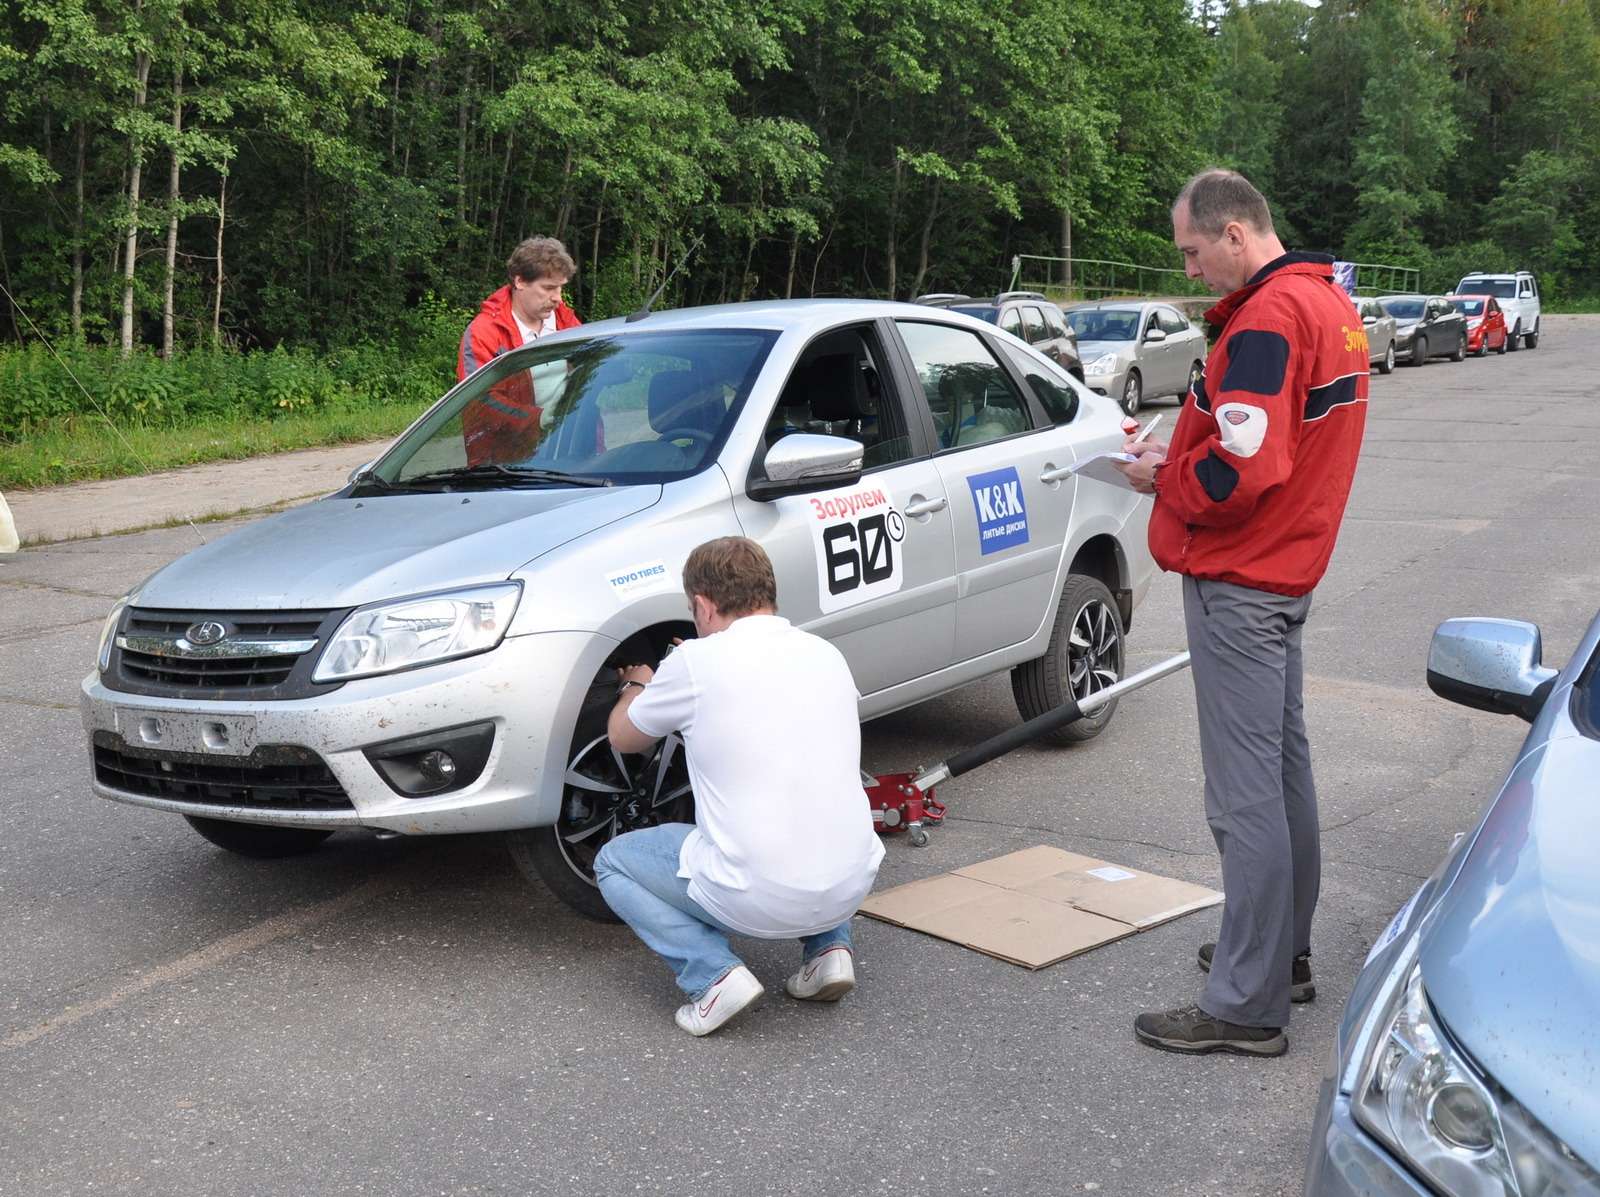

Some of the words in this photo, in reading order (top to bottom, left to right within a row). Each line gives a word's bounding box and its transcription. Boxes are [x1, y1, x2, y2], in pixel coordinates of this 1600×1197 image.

[810, 488, 887, 519] Зарулем
[975, 481, 1024, 523] K&K
[983, 526, 1005, 540] литые
[1006, 520, 1026, 534] диски
[823, 513, 893, 595] 60
[610, 573, 638, 586] TOYO
[638, 565, 665, 579] TIRES
